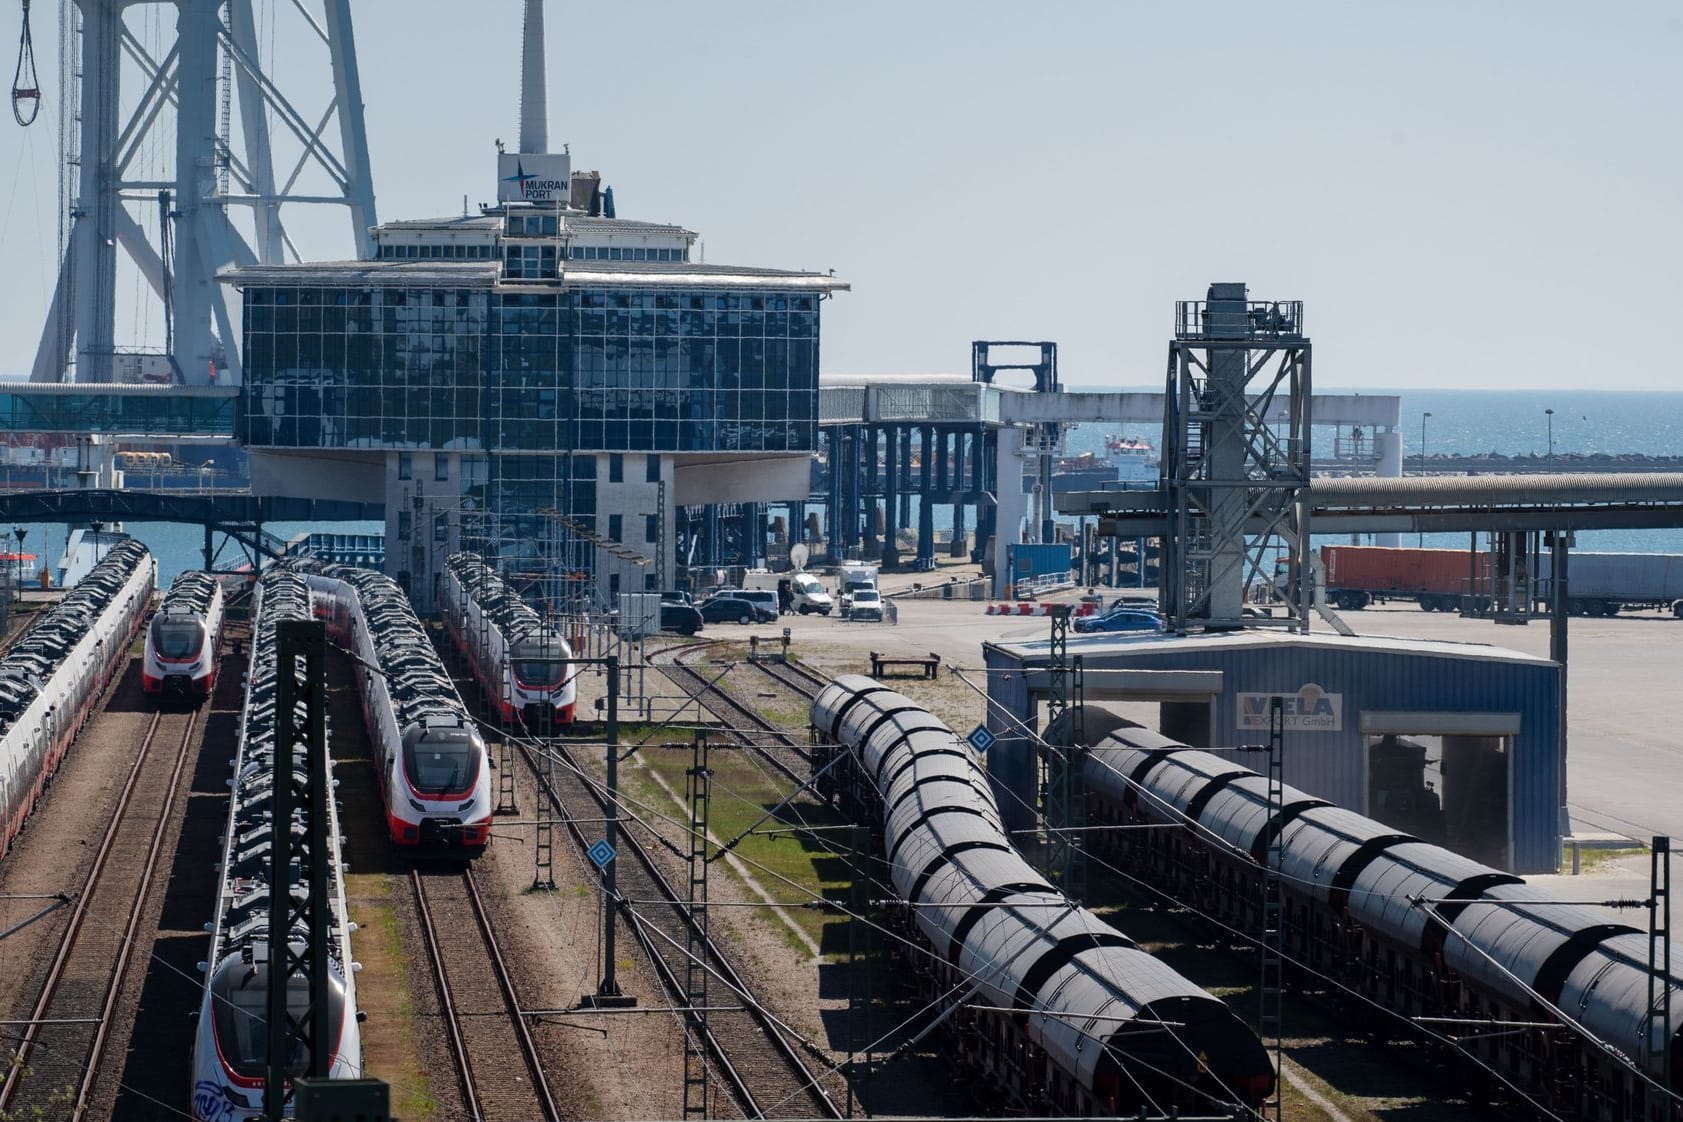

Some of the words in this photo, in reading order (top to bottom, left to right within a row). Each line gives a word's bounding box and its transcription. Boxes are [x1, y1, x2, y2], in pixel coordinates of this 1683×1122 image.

[526, 180, 568, 190] MUKRAN
[526, 190, 552, 199] PORT
[1302, 716, 1336, 726] GmbH
